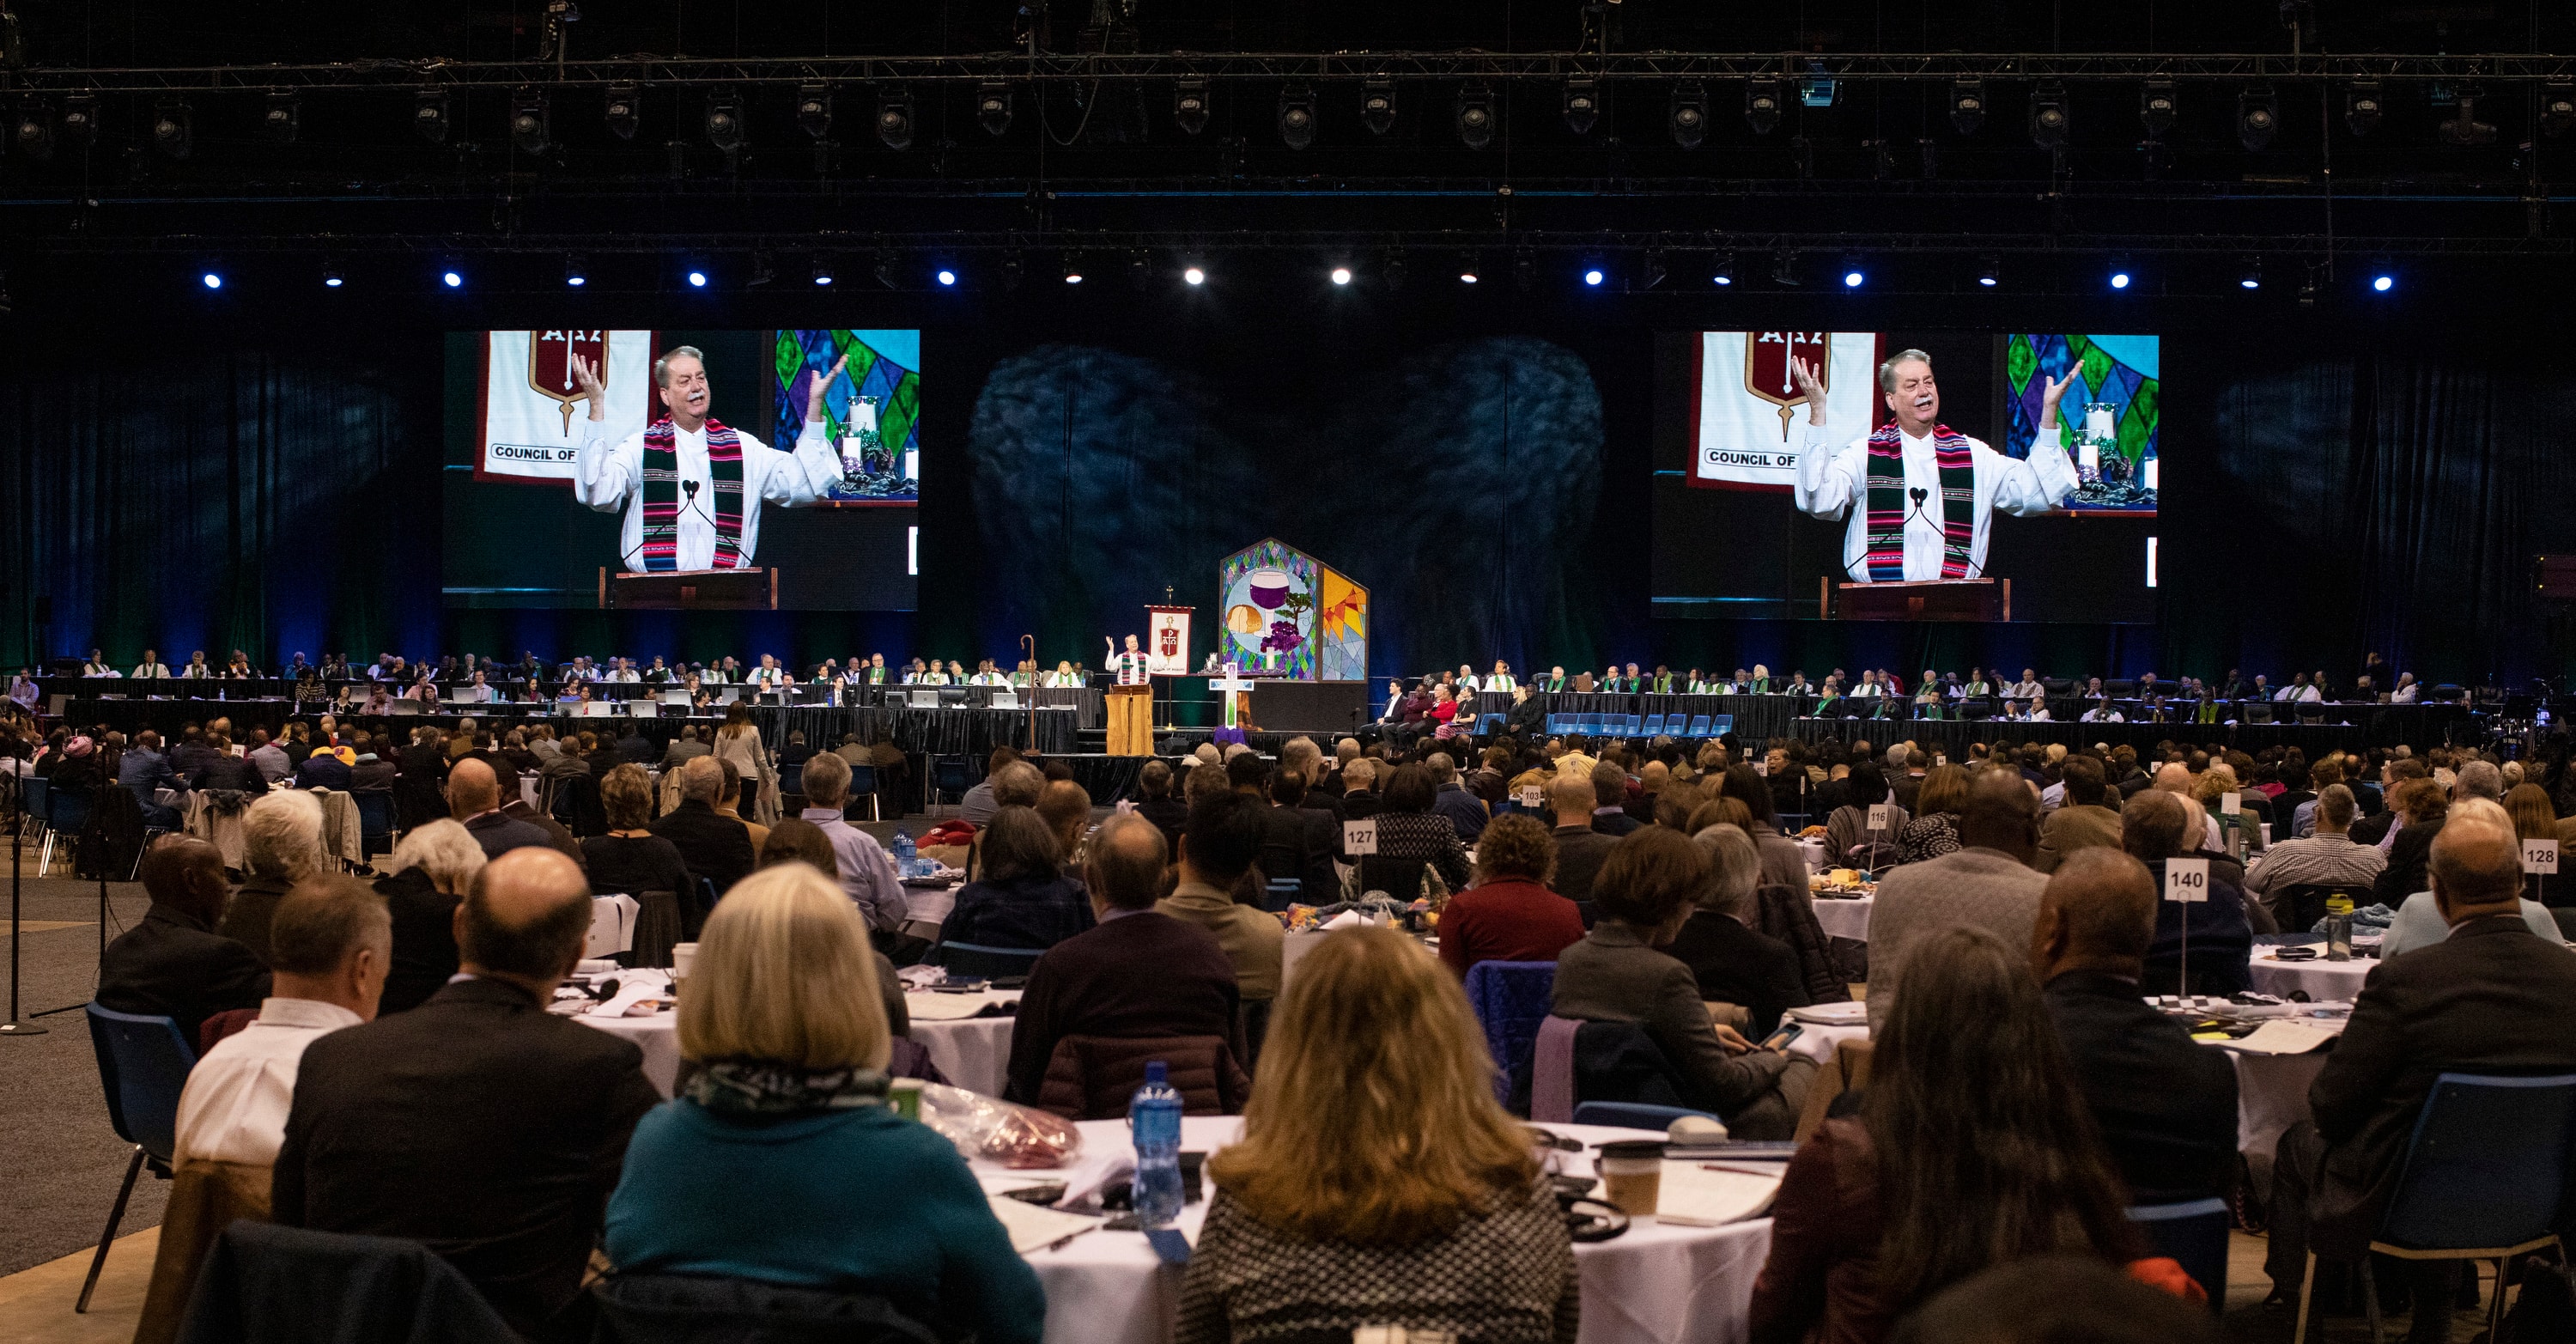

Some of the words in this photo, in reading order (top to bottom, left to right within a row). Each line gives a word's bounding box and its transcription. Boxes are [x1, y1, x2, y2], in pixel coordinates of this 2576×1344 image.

[495, 447, 552, 460] COUNCIL
[557, 450, 575, 460] OF
[1710, 451, 1771, 465] COUNCIL
[1777, 456, 1795, 466] OF
[1525, 792, 1540, 800] 103
[1871, 812, 1886, 822] 116
[1348, 830, 1373, 843] 127
[2527, 849, 2555, 863] 128
[2171, 872, 2203, 888] 140
